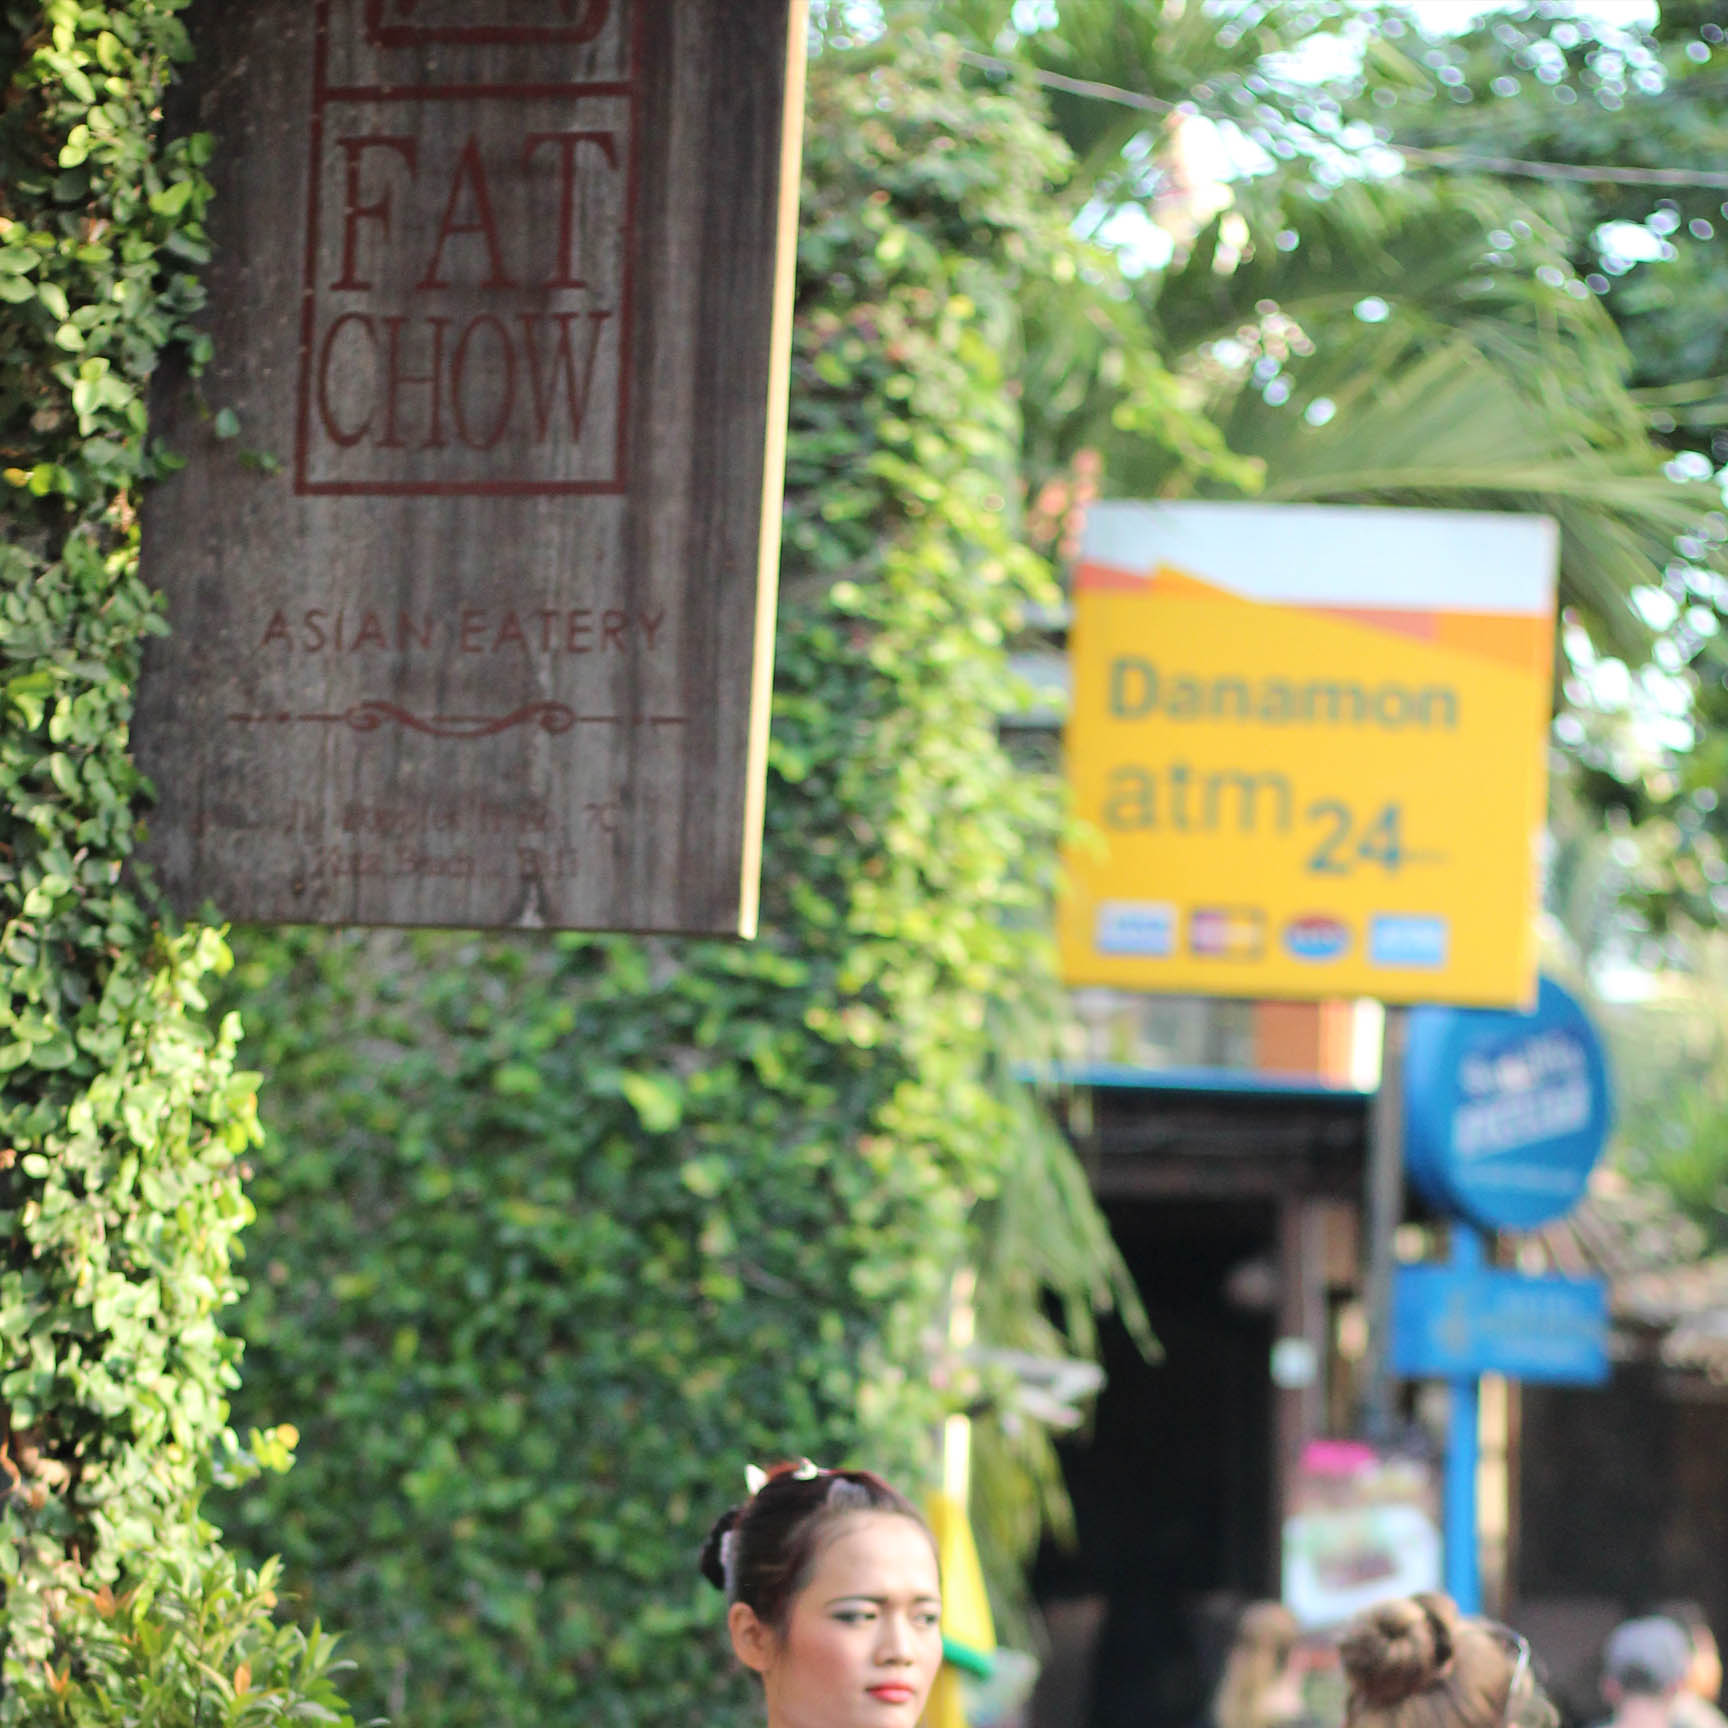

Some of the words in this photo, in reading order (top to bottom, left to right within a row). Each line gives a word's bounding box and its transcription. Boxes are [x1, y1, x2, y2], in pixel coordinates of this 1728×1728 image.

[330, 132, 619, 291] FAT
[318, 311, 613, 449] CHOW
[262, 608, 435, 653] ASIAN
[459, 608, 665, 653] EATERY
[1107, 655, 1459, 730] Danamon
[1105, 762, 1294, 836] atm
[1306, 800, 1403, 876] 24
